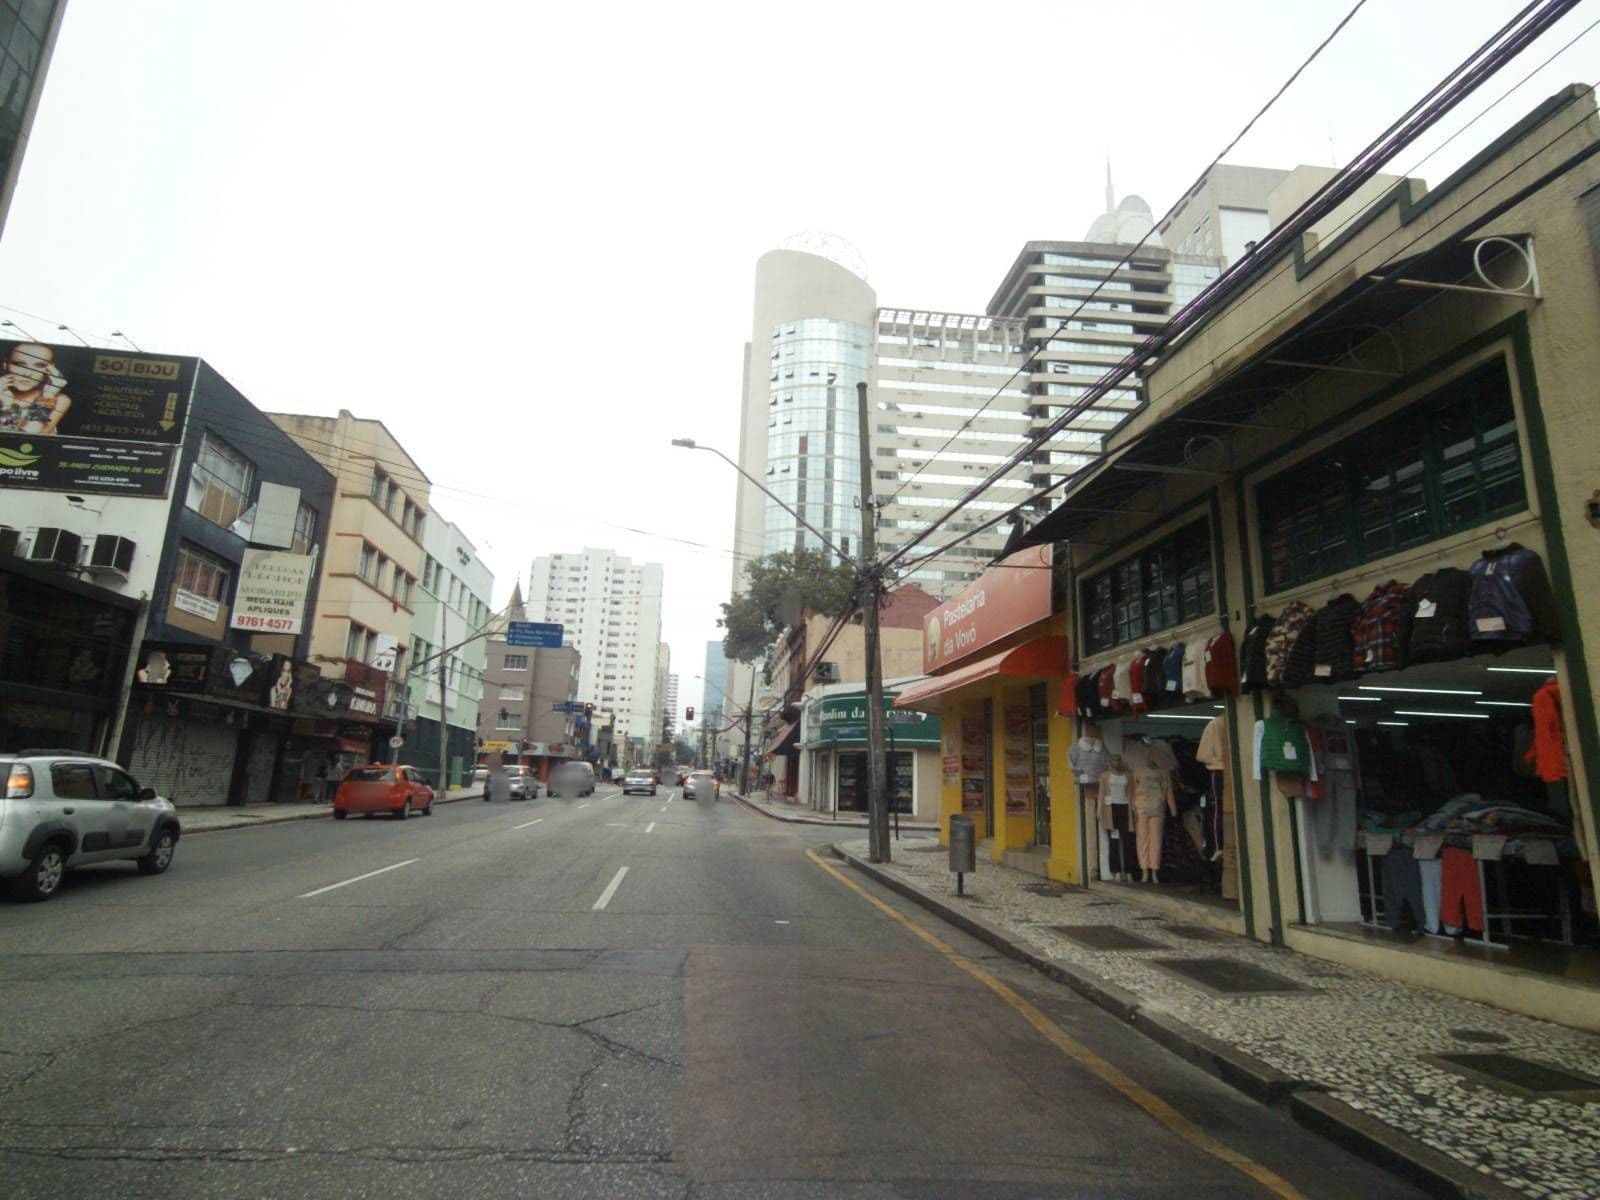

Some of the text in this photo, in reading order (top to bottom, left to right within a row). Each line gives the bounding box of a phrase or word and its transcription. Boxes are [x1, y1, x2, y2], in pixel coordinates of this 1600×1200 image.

[134, 363, 175, 376] BIJU
[15, 467, 39, 477] livre
[246, 596, 295, 607] MEGA HAIR
[247, 605, 291, 615] APLIQUES
[943, 589, 985, 628] Pastelaria
[237, 615, 293, 630] 9761-4577
